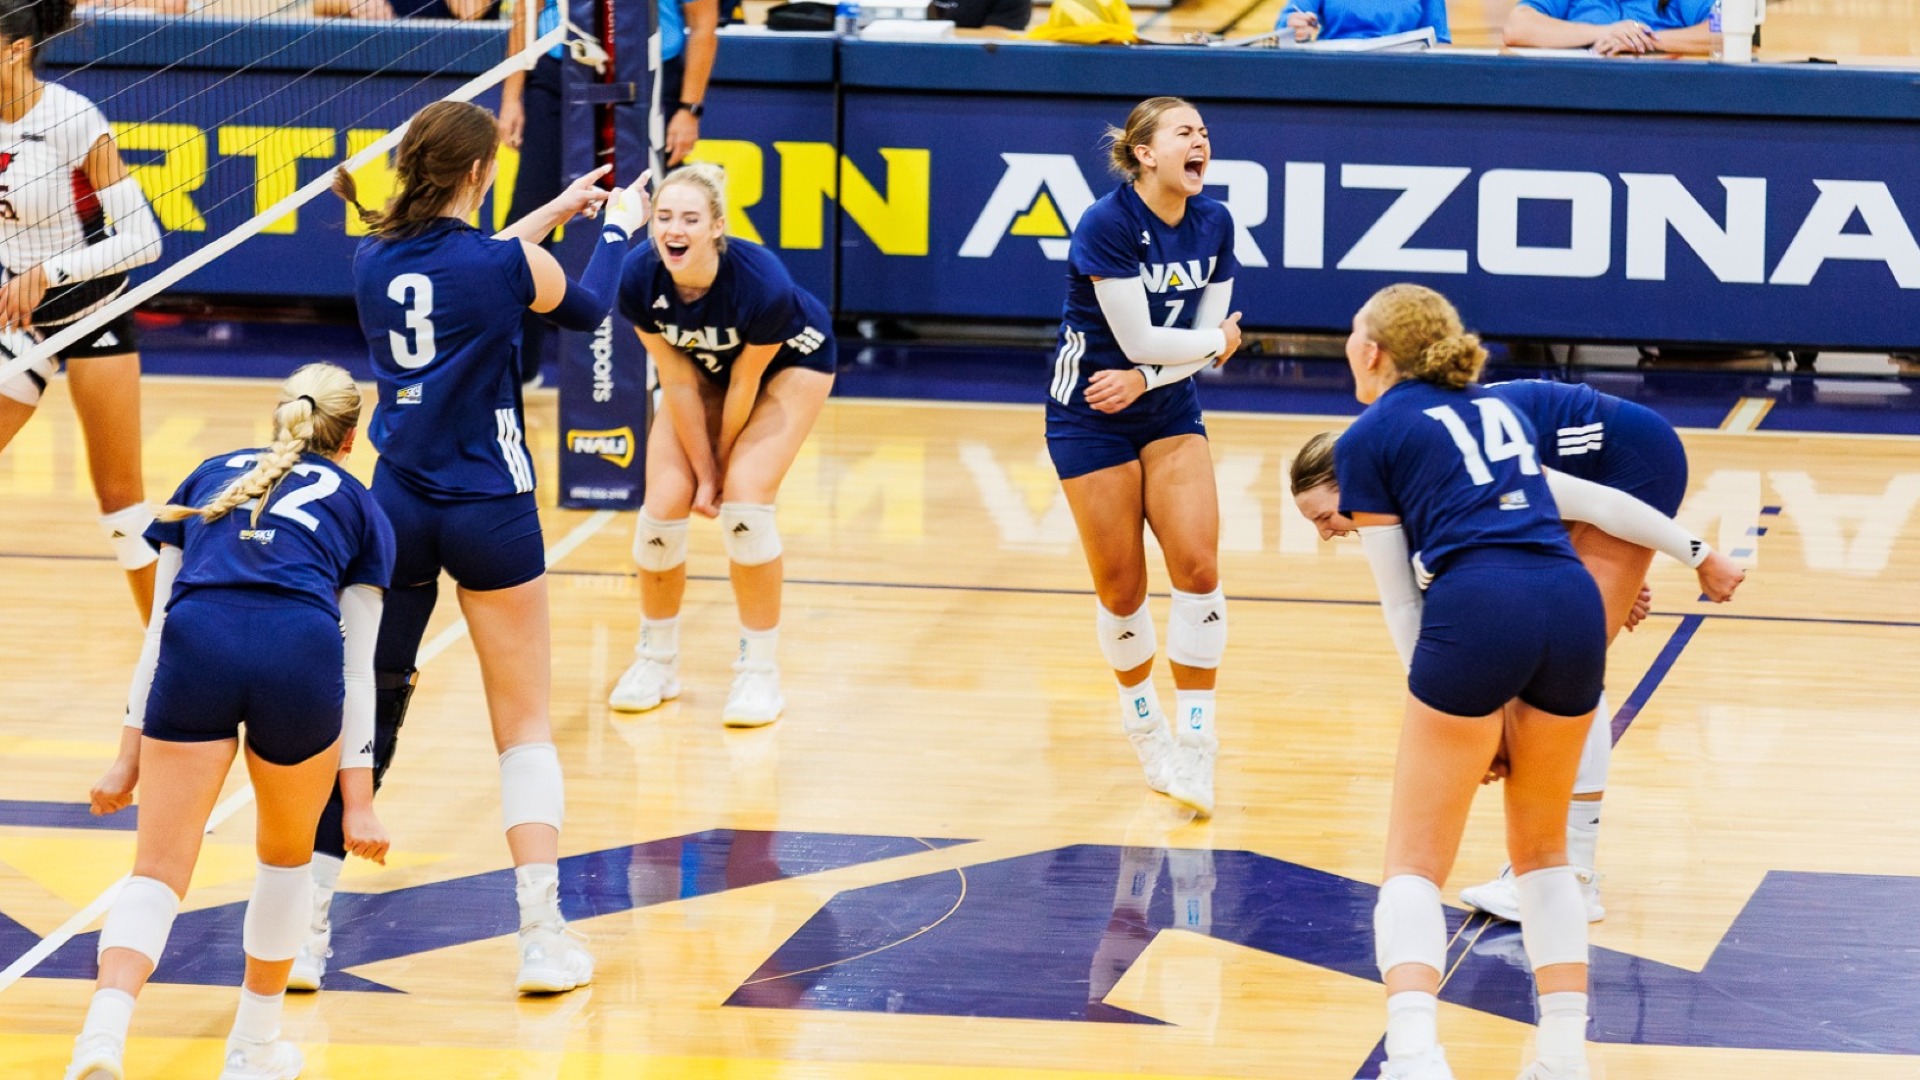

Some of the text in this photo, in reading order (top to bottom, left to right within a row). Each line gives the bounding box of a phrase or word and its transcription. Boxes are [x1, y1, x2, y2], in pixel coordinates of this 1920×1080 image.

[957, 152, 1920, 289] ARIZONA
[1139, 256, 1217, 293] NAU
[387, 272, 436, 369] 3
[654, 319, 741, 351] NAU
[1163, 299, 1185, 327] 7
[574, 437, 627, 455] NAU
[1422, 397, 1540, 486] 14
[225, 454, 342, 532] 22
